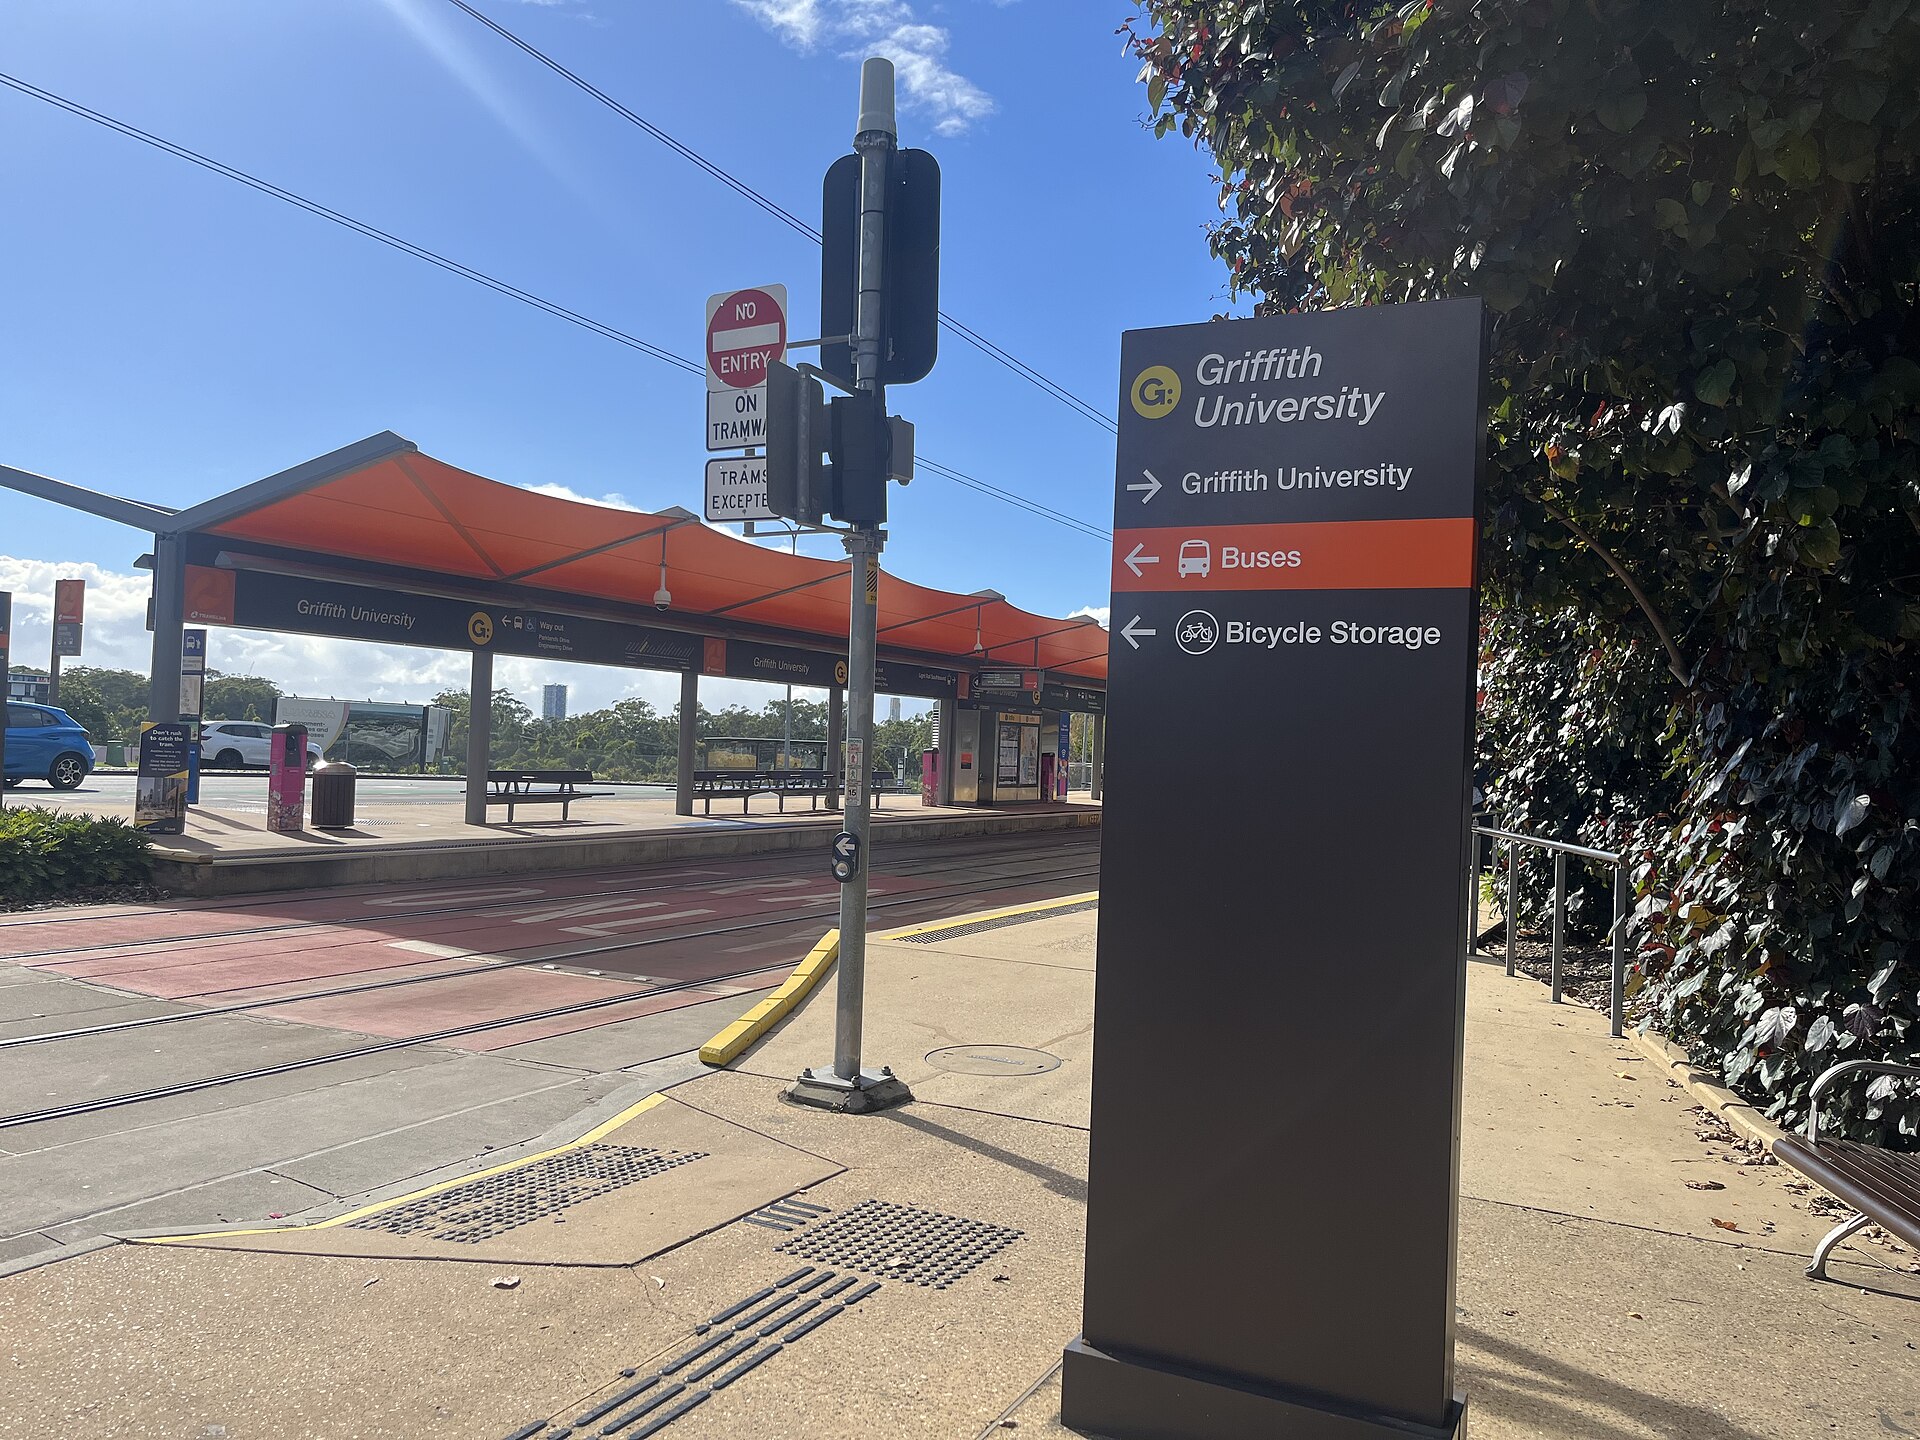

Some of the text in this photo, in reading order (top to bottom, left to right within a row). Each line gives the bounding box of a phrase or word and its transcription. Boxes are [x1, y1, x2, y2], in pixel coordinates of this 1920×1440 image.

[735, 302, 756, 321] NO
[721, 350, 770, 374] ENTRY
[1196, 346, 1323, 386] Griffith
[735, 394, 757, 413] ON
[1194, 386, 1385, 428] University
[713, 418, 767, 440] TRAMW
[1181, 463, 1413, 494] Griffith University
[712, 493, 768, 509] EXCEPTE
[1221, 547, 1301, 569] Buses
[297, 599, 416, 630] Griffith University
[540, 621, 553, 631] Way
[1226, 621, 1441, 649] Bicycle Storage
[753, 656, 810, 675] Griffith University
